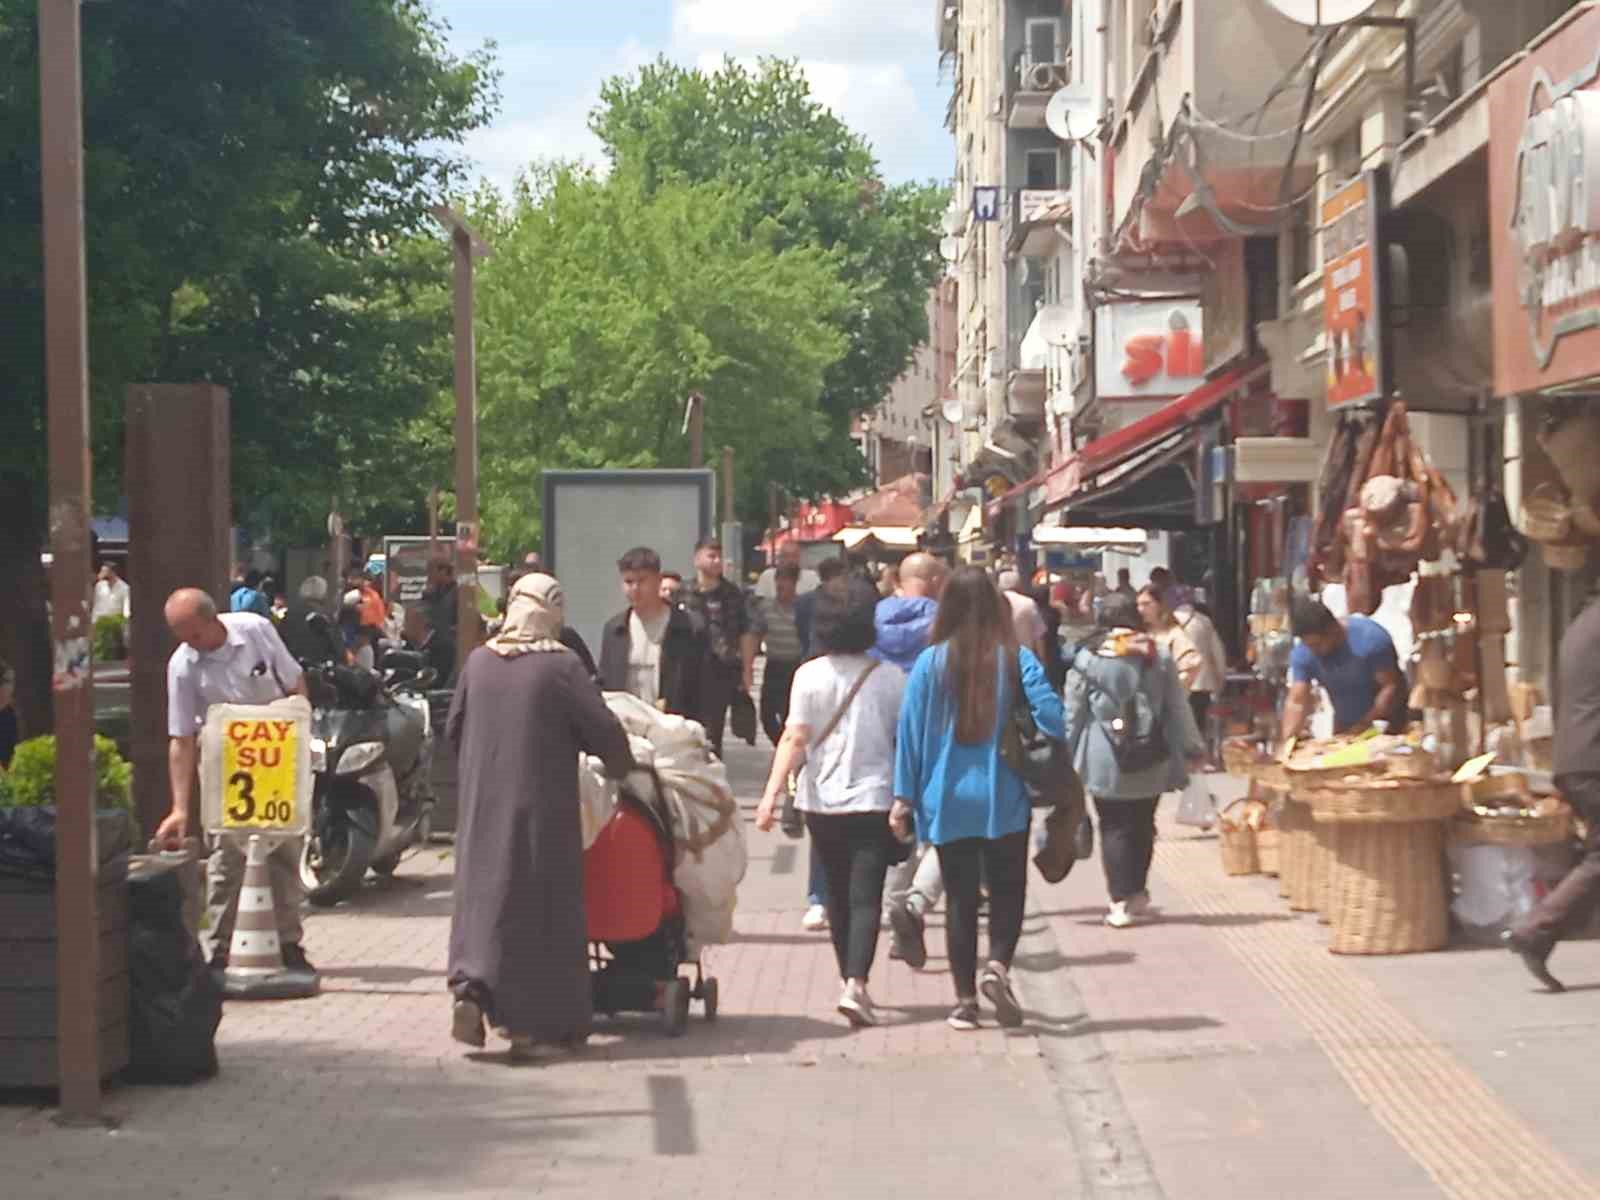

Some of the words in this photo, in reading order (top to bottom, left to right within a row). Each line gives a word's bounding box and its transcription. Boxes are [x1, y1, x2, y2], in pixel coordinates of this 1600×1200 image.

[228, 720, 295, 746] ÇAY
[237, 747, 280, 767] SU
[228, 771, 291, 822] 3.00
